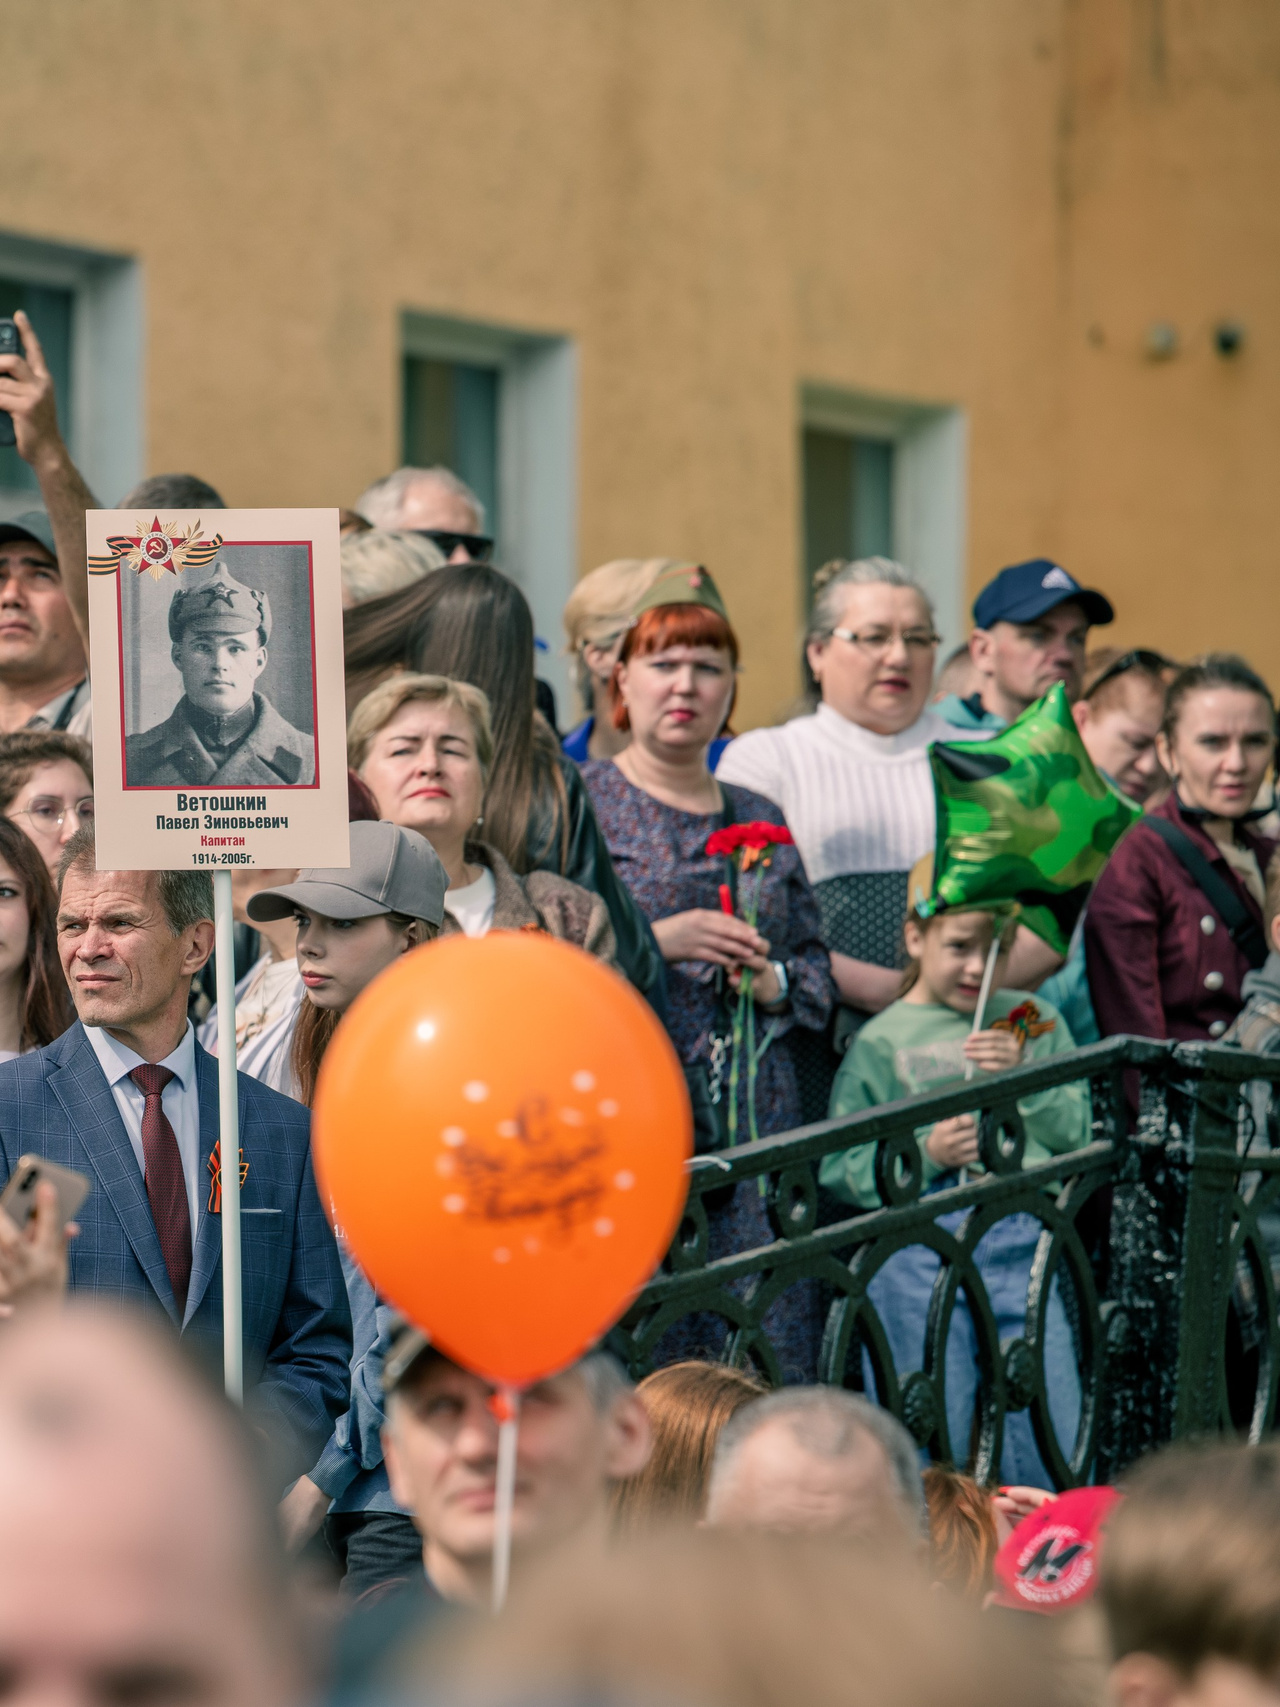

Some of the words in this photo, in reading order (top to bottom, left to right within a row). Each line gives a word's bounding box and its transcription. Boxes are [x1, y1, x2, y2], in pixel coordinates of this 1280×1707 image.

[176, 793, 267, 812] Ветошкин
[156, 814, 200, 830] Павел
[204, 814, 289, 830] Зиновьевич
[200, 835, 246, 847] Капитан
[191, 852, 256, 865] 1914-2005г.
